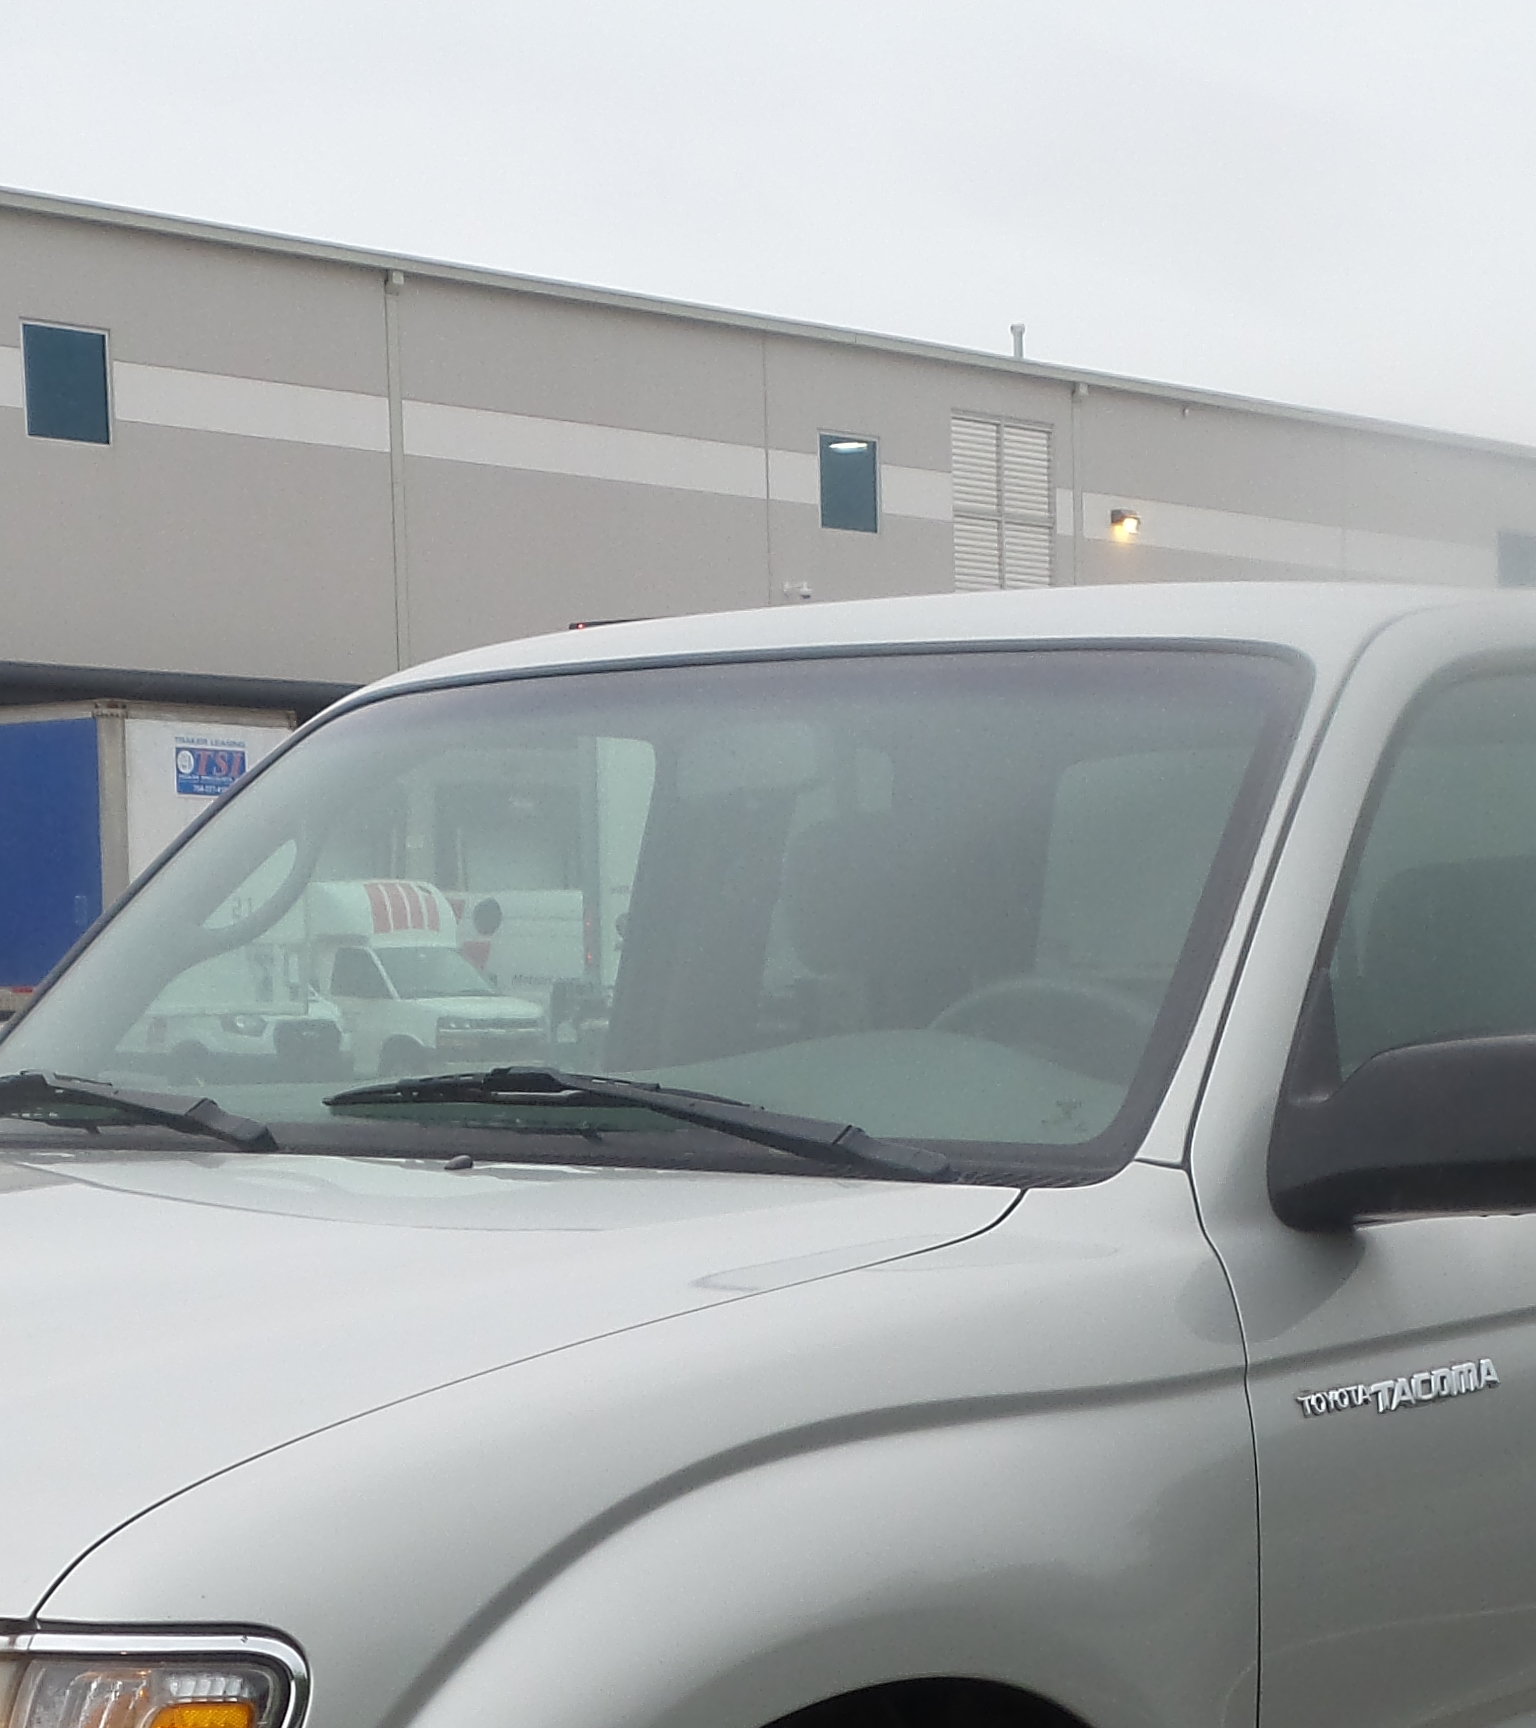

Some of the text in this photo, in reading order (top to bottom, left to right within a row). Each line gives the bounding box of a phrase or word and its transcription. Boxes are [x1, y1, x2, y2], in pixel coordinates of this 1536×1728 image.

[196, 750, 243, 778] TSI
[1297, 1357, 1501, 1418] TOYOTA TACOMA
